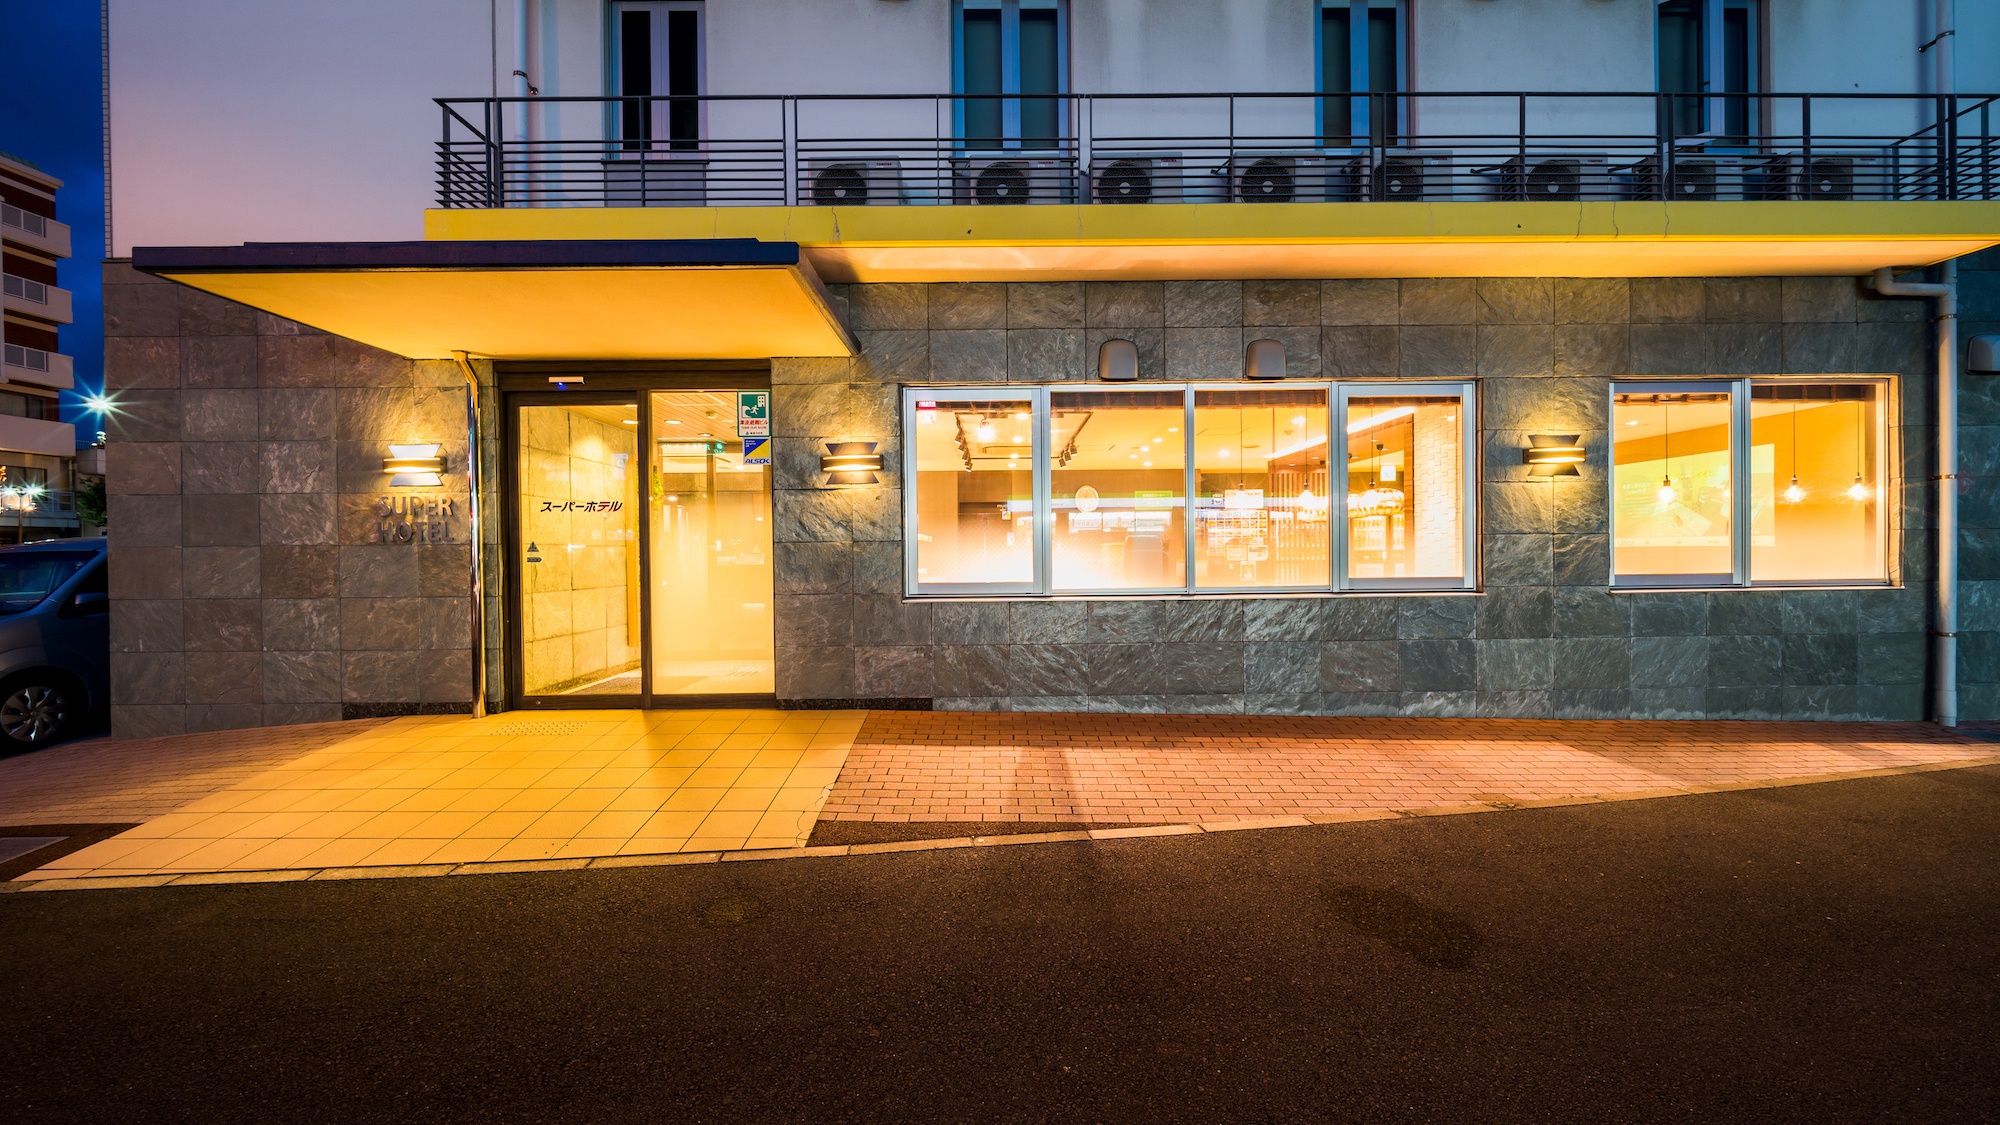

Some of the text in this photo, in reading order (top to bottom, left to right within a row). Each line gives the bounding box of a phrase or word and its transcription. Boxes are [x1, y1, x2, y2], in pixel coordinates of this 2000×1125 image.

[377, 496, 453, 517] SUPER
[540, 501, 623, 512] スーパーホテル
[377, 521, 454, 542] HOTEL
